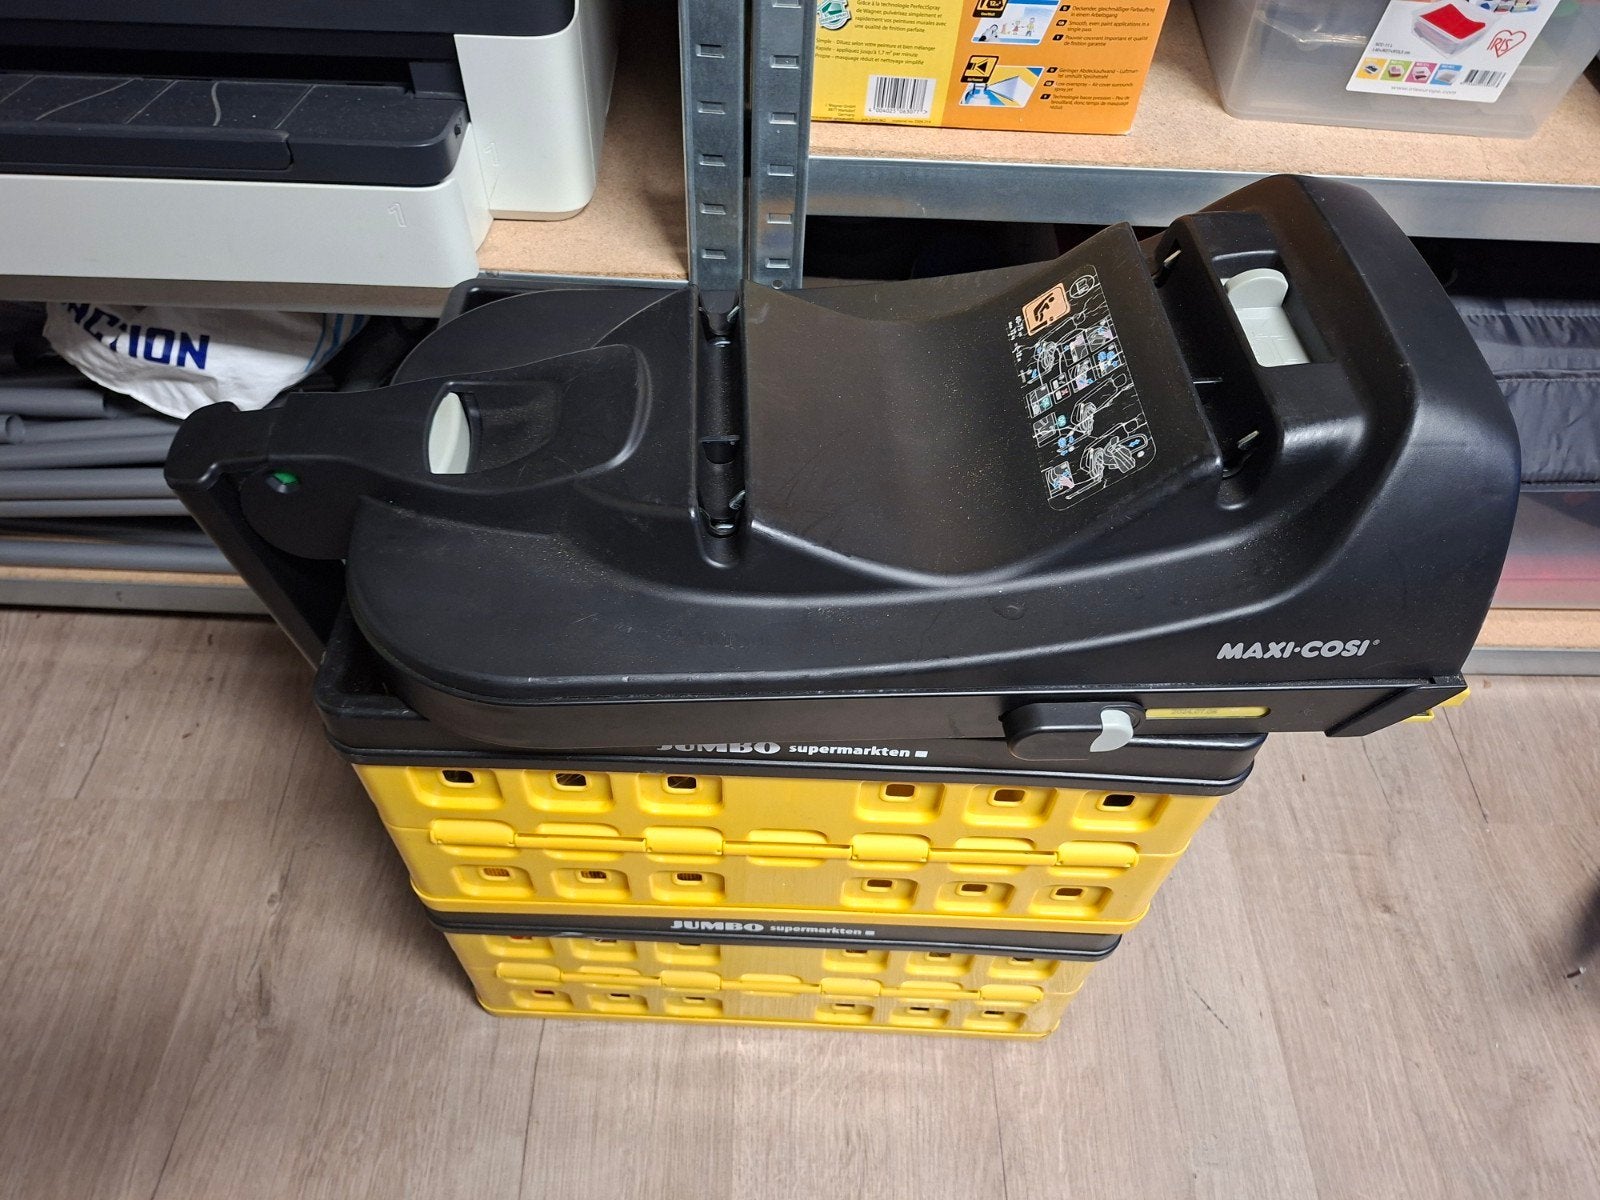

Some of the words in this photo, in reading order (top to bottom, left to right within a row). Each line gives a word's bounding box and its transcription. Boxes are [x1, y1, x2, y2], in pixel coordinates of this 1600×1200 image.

[789, 744, 910, 758] supermarkten
[670, 920, 764, 932] JUMBO
[770, 925, 862, 936] supermarkten
